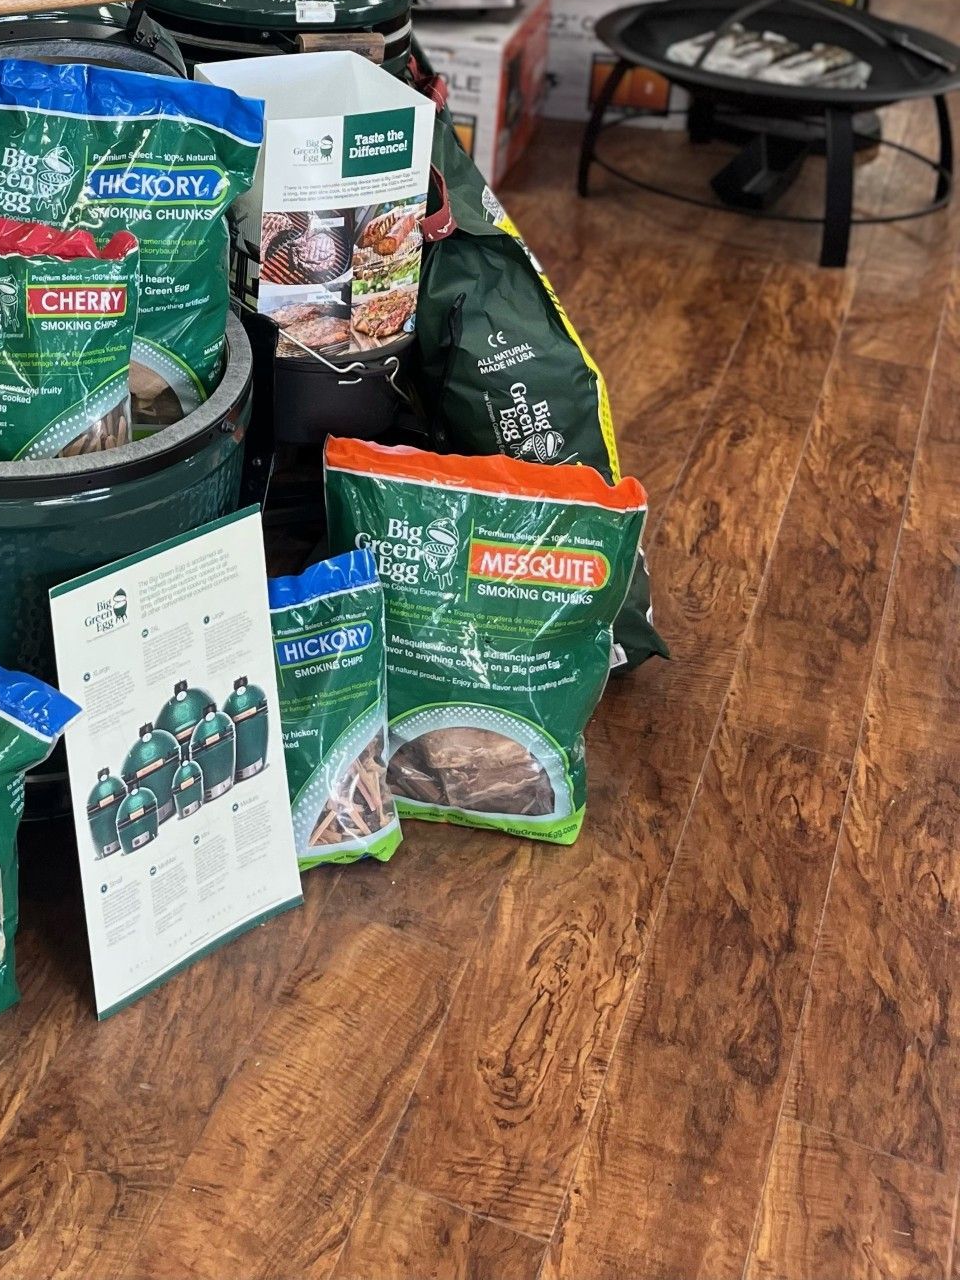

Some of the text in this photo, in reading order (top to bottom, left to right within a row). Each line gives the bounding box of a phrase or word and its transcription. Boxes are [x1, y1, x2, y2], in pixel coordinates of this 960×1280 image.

[305, 139, 320, 148] Big
[354, 130, 404, 146] Taste the
[186, 153, 217, 162] Natural
[293, 147, 320, 156] Green
[303, 154, 320, 163] Egg
[349, 140, 408, 159] Difference!
[2, 147, 39, 174] Big
[99, 172, 203, 197] HICKORY
[90, 208, 214, 221] SMOKING CHUNKS
[141, 275, 175, 285] hearty
[144, 283, 191, 296] Green Egg
[41, 291, 122, 313] CHERRY
[40, 319, 118, 331] SMOKING CHIPS
[477, 342, 532, 368] ALL NATURAL
[479, 351, 535, 375] MADE IN USA
[2, 393, 31, 404] cooked
[41, 386, 62, 396] fruity
[510, 382, 535, 437] Green
[532, 400, 552, 433] Big
[499, 407, 522, 442] Egg
[388, 518, 424, 545] Big
[478, 528, 603, 547] Premium Natural
[354, 532, 424, 561] Green
[378, 559, 420, 584] Egg
[479, 551, 595, 583] MESQUITE
[392, 583, 418, 595] Cooking
[477, 584, 594, 605] SMOKING CHUNKS
[96, 599, 113, 613] Big
[84, 609, 114, 628] Green
[96, 619, 114, 633] Egg
[304, 621, 324, 631] Select
[346, 611, 367, 620] Natural
[284, 626, 368, 662] HICKORY
[392, 635, 535, 662] Mesquite distinctive
[294, 654, 363, 679] SMOKING CHIPS
[405, 648, 414, 657] to
[416, 651, 454, 666] anything
[512, 662, 527, 675] Big
[528, 664, 546, 674] Green
[548, 660, 560, 670] Egg
[395, 666, 536, 693] natural product Enjoy flavor without
[291, 728, 319, 739] hickory
[506, 823, 578, 840] BigGreenEgg.com
